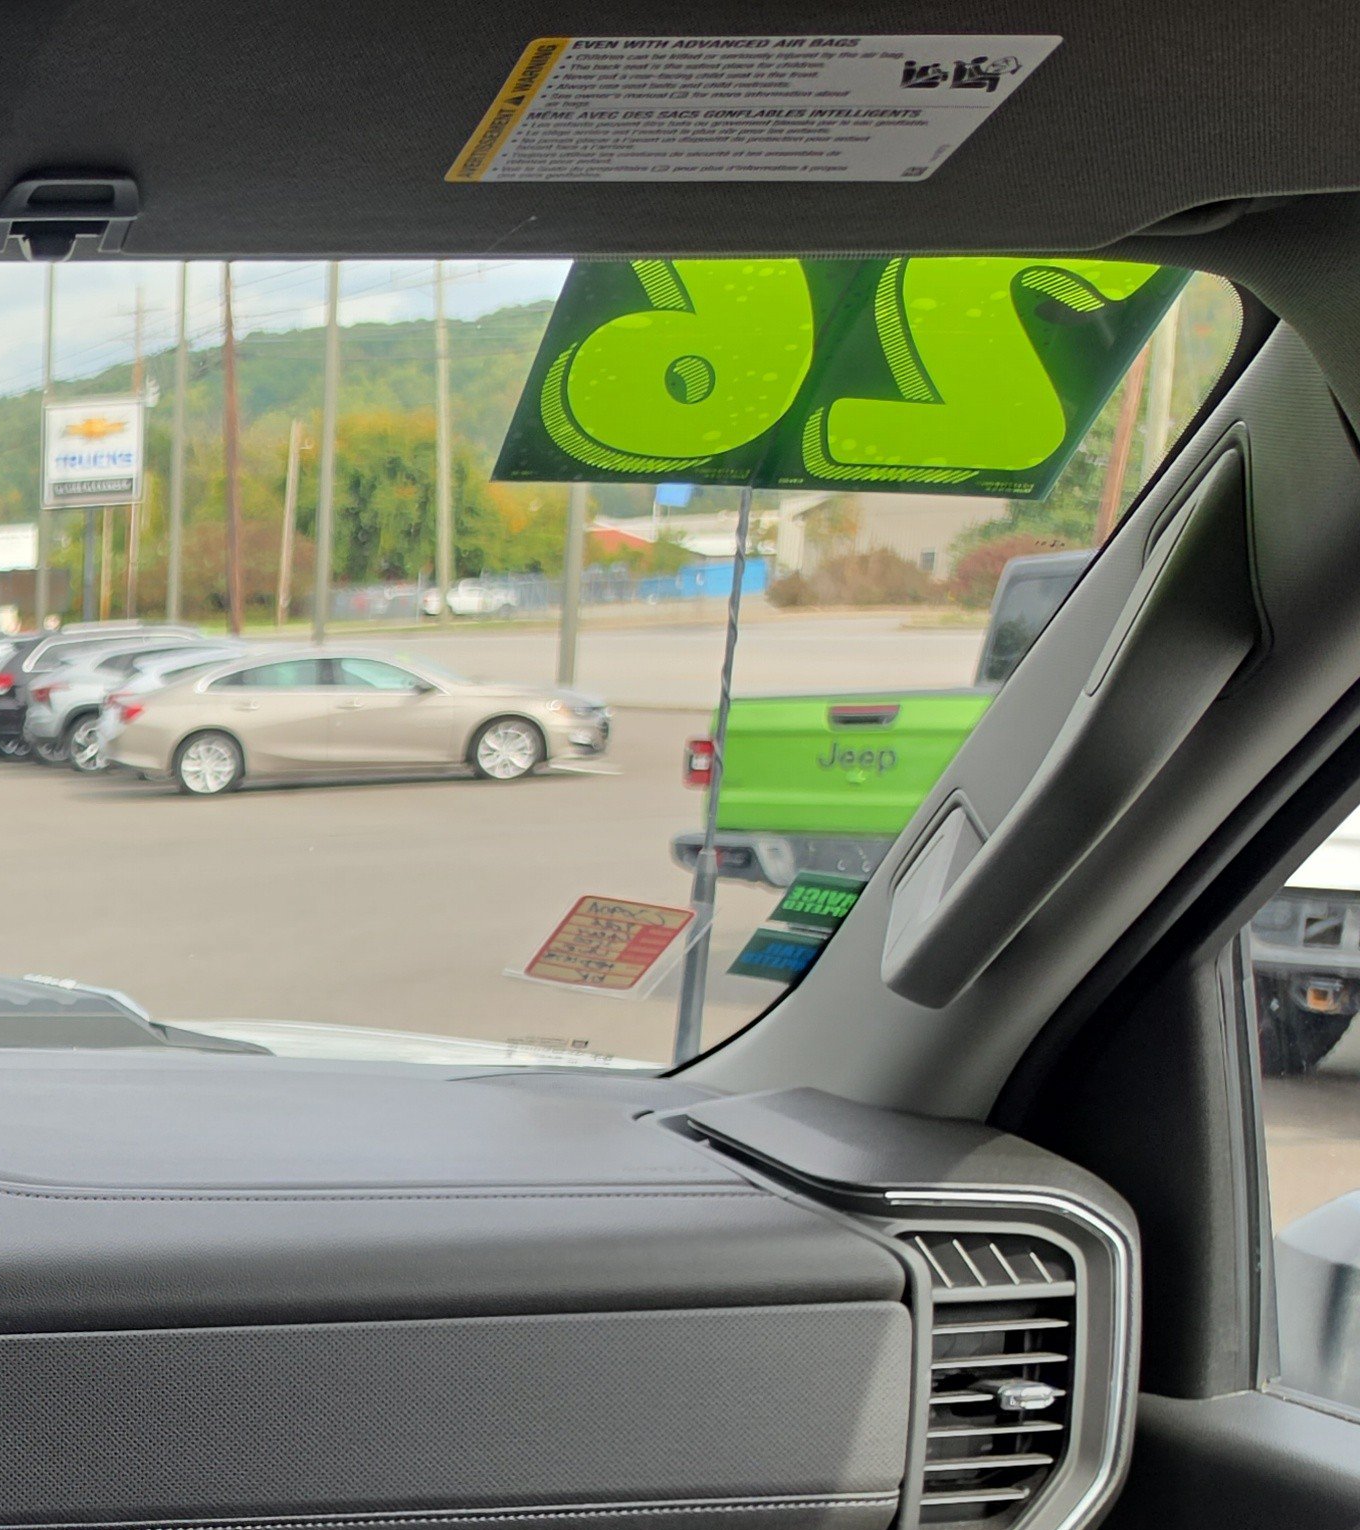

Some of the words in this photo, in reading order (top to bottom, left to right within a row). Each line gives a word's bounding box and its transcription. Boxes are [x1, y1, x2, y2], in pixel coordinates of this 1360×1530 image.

[572, 40, 618, 50] EVEN
[623, 40, 671, 50] WITH
[673, 39, 770, 49] ADVANCED
[773, 39, 806, 48] AIR
[810, 38, 861, 48] BAGS
[511, 44, 557, 93] WARNING
[527, 109, 576, 120] MÊME
[579, 110, 619, 120] AVEC
[621, 110, 655, 119] DES
[658, 110, 700, 119] SACS
[704, 109, 808, 119] GONFLABLES
[810, 108, 922, 118] INTELLIGENTS
[819, 741, 896, 773] Jeep
